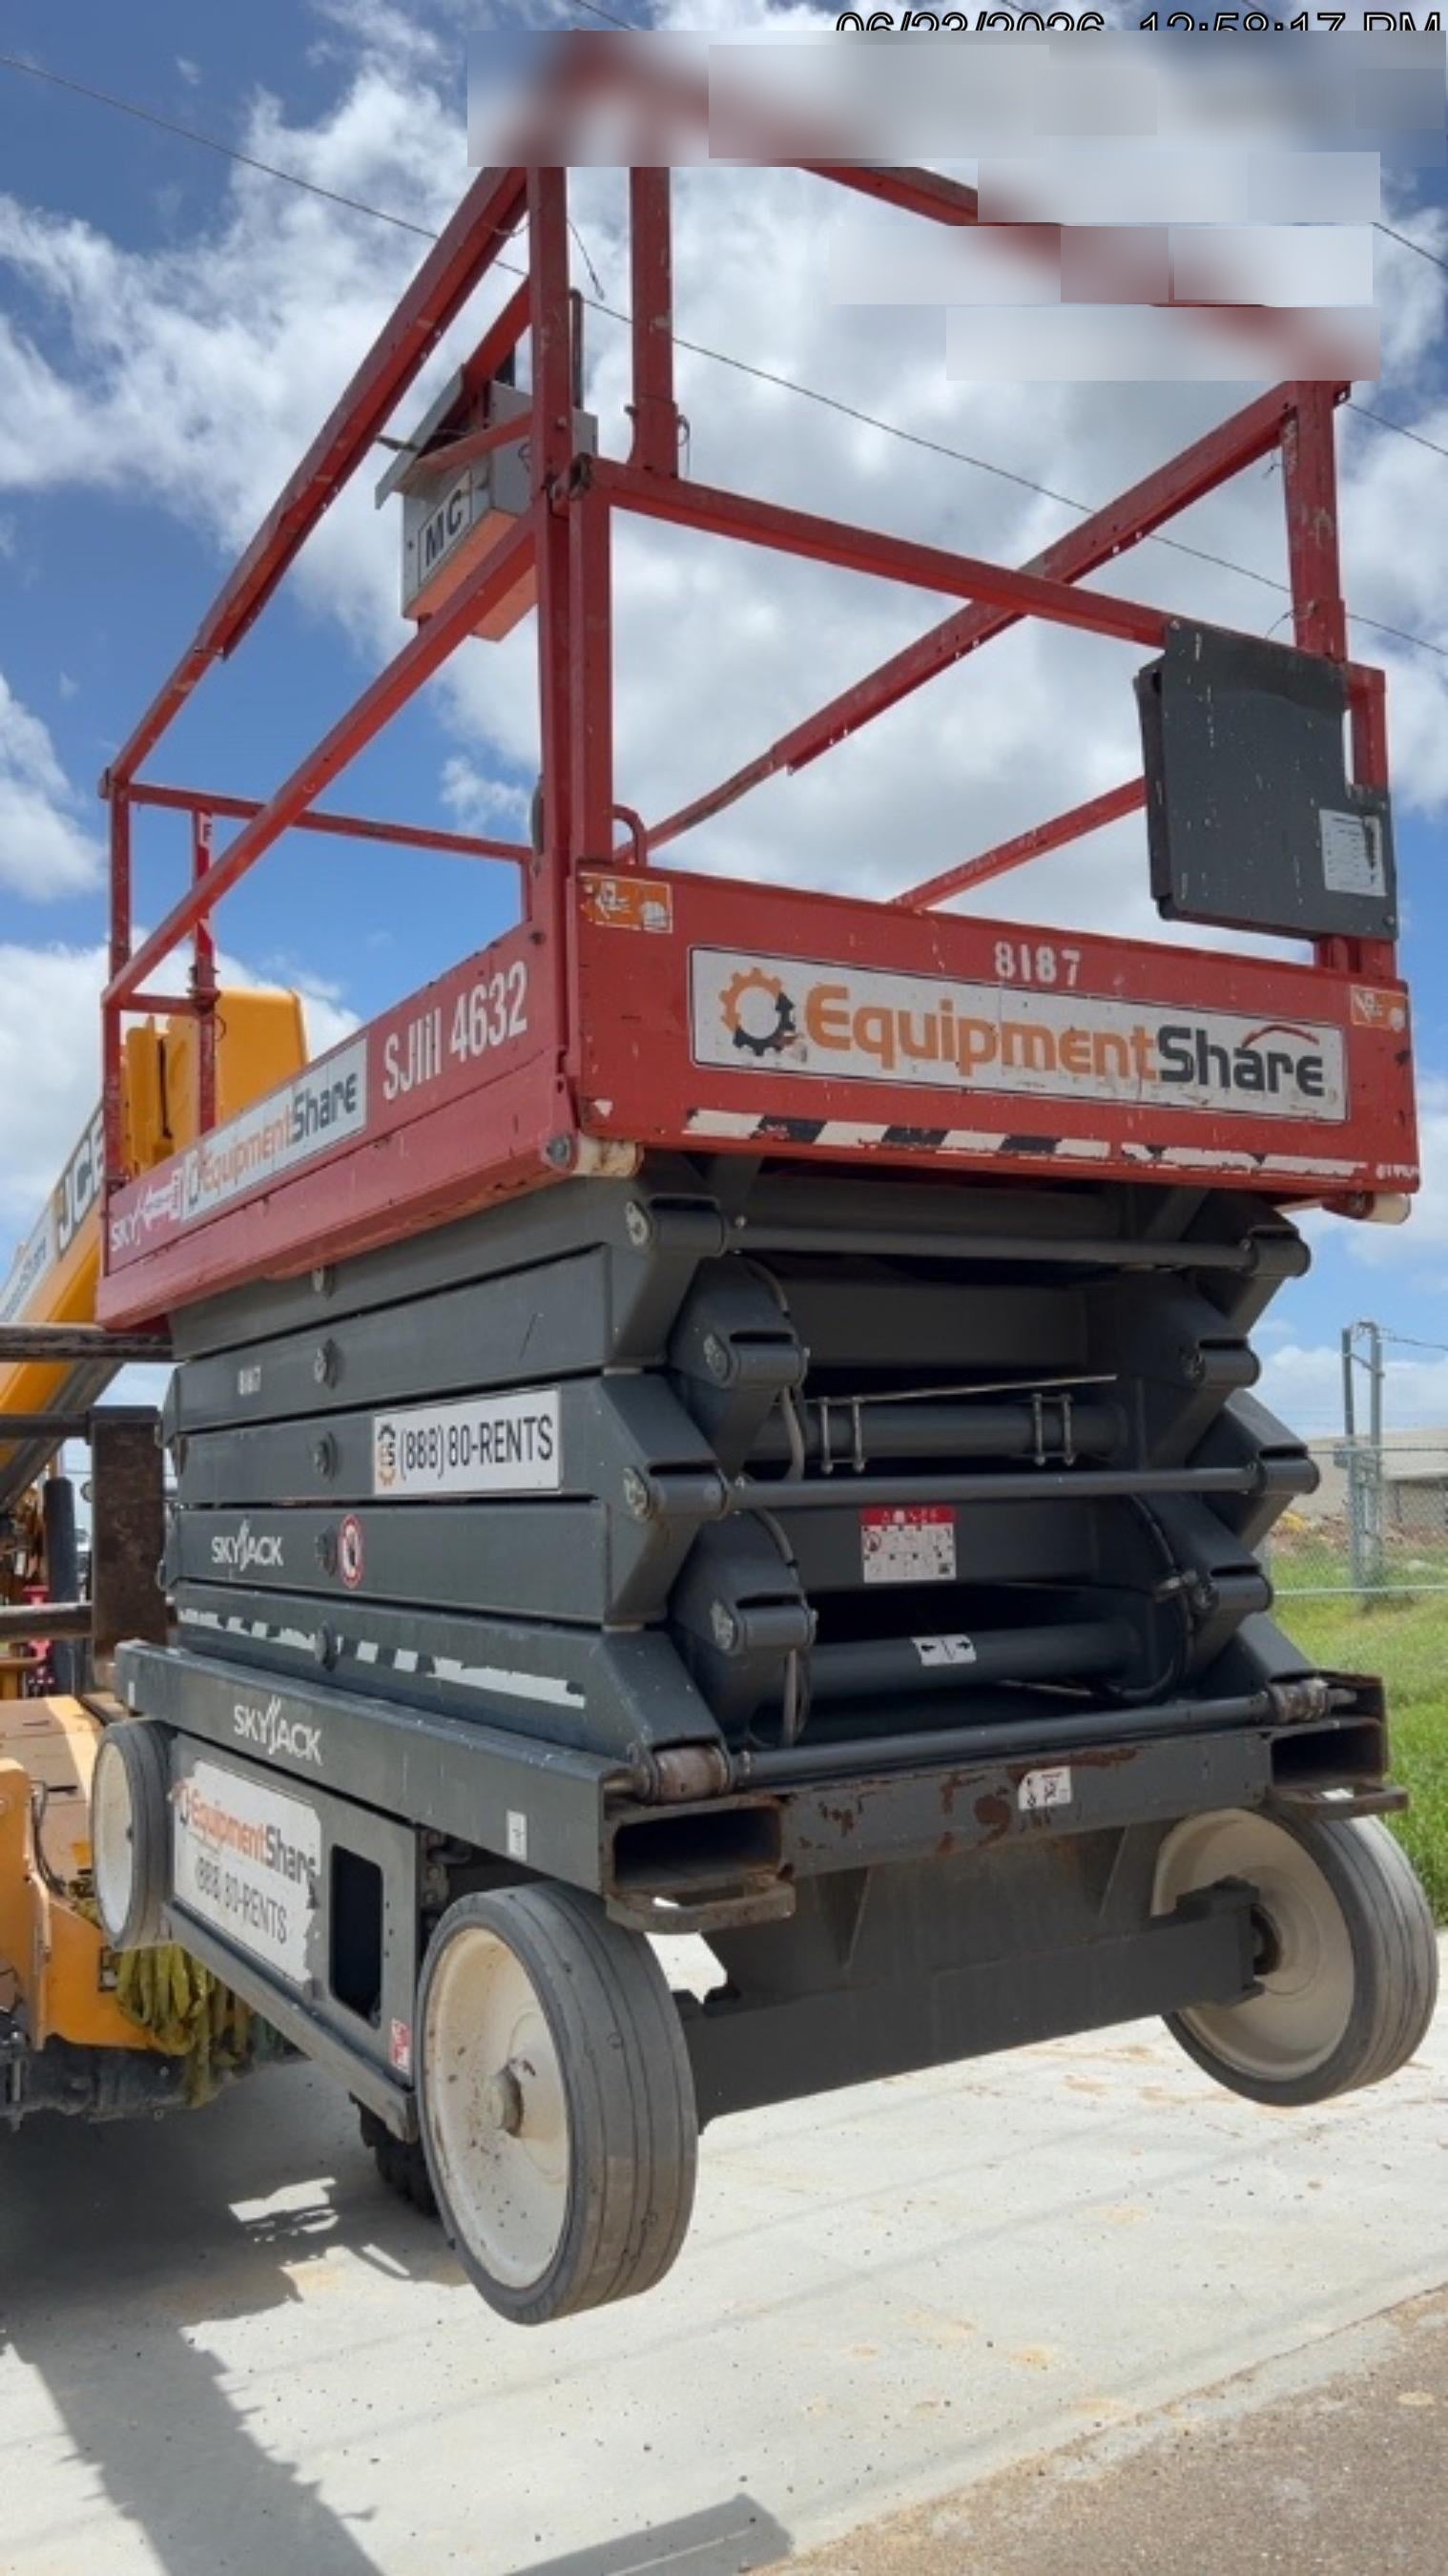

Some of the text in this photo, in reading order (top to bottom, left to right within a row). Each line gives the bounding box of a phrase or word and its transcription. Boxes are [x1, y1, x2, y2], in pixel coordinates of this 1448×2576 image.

[425, 488, 463, 569] MC
[995, 940, 1081, 987] 8187
[449, 960, 527, 1064] 4632
[804, 983, 1325, 1097] EquipmentShare
[448, 1413, 553, 1466] 80-RENTS
[211, 1518, 284, 1572] SKYJACK
[234, 1694, 323, 1767] SKYJACK
